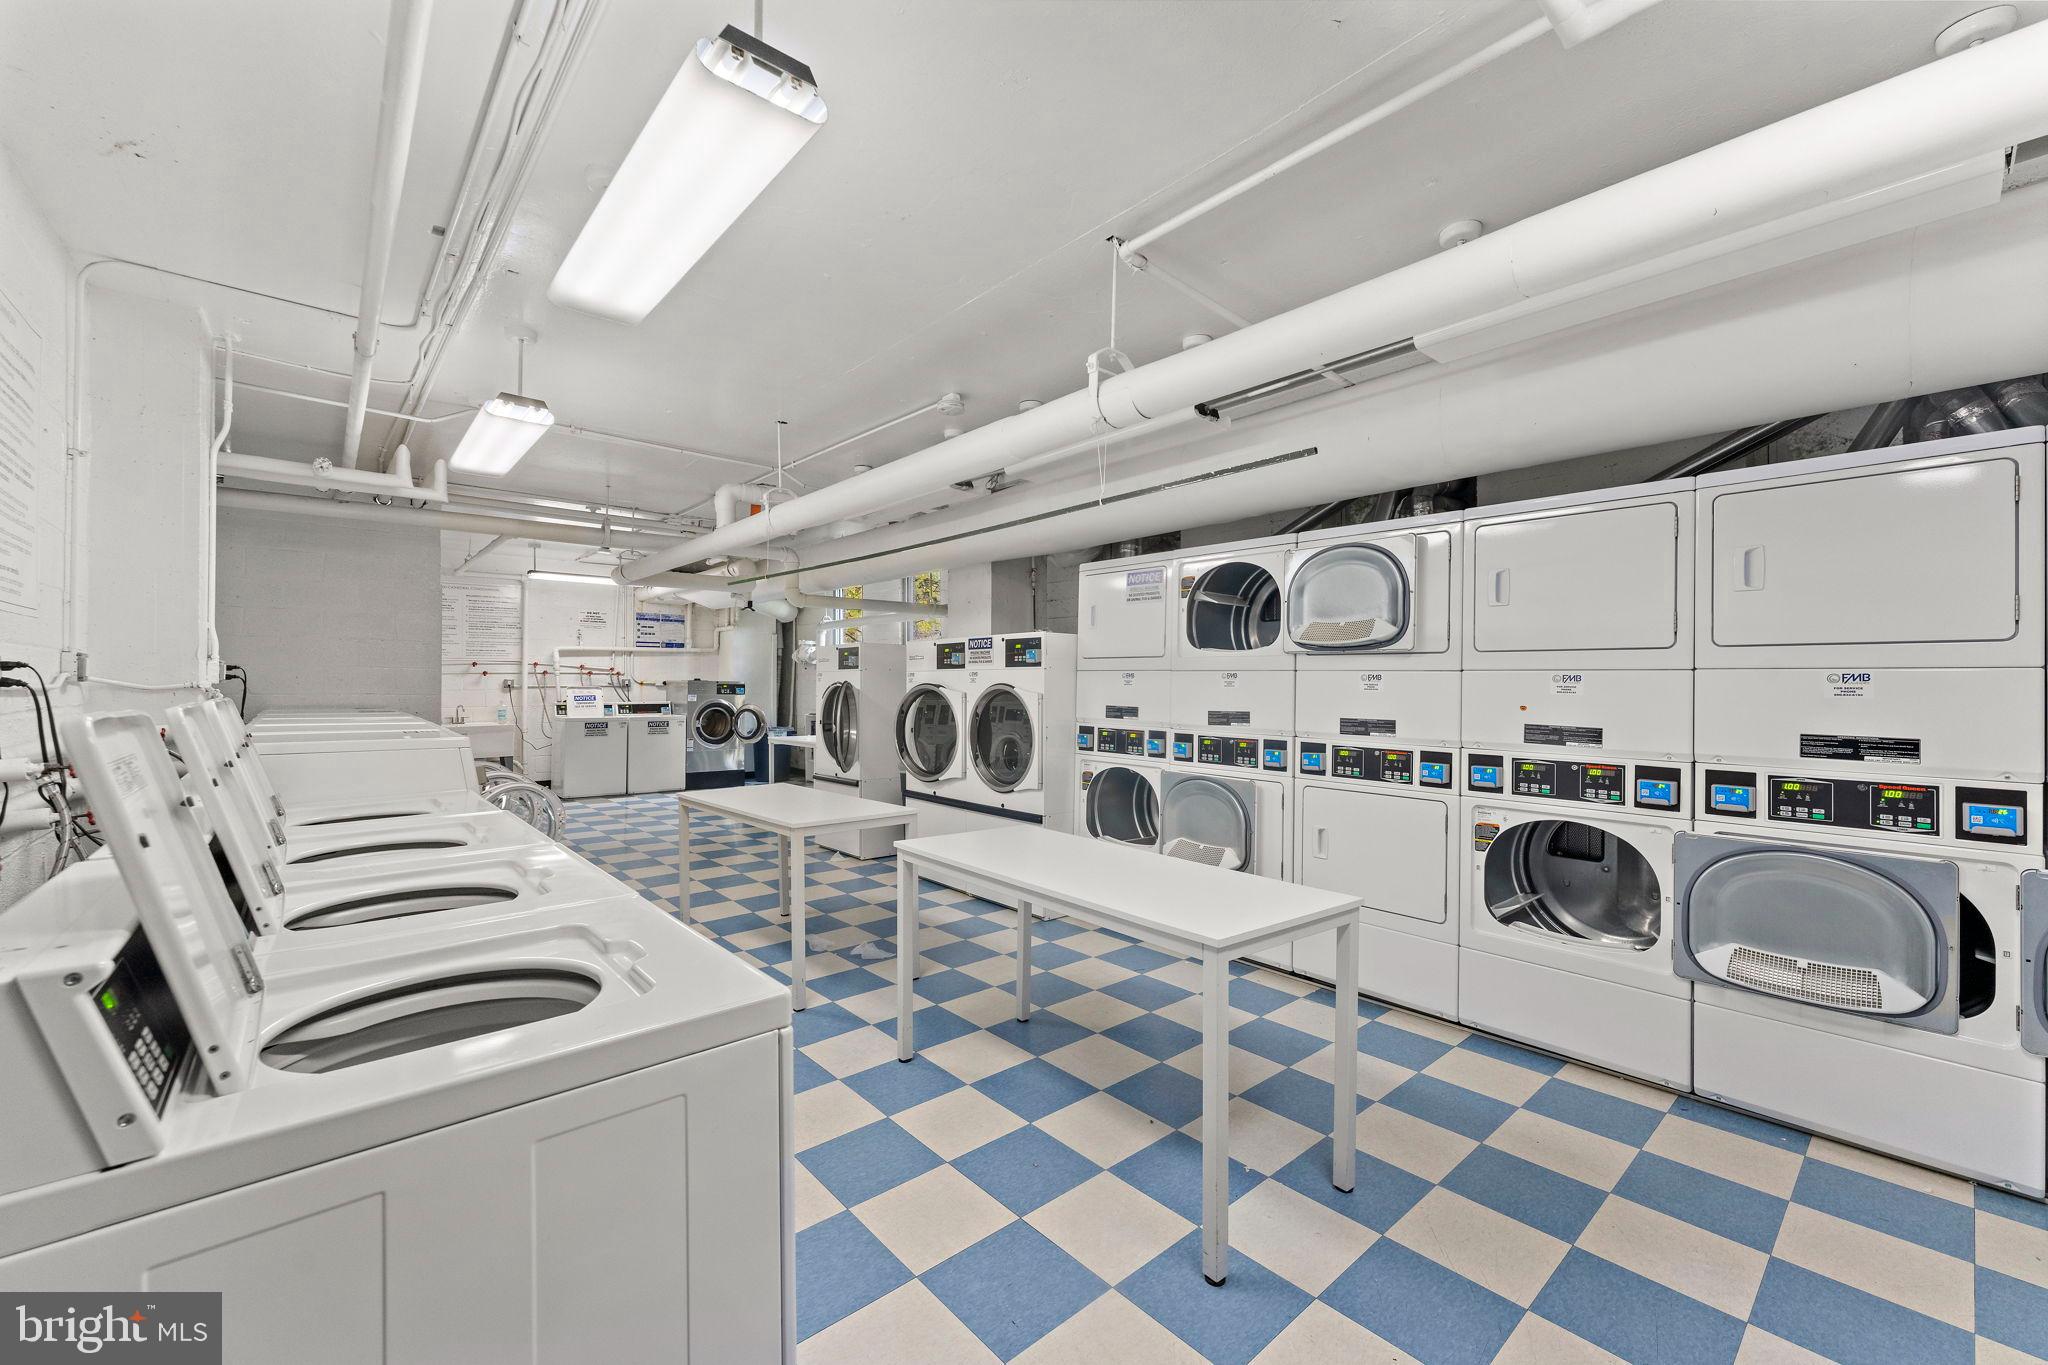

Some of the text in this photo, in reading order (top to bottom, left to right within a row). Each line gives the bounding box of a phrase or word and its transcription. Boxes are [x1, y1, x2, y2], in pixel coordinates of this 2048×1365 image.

[1128, 572, 1161, 585] NOTICE
[969, 639, 992, 649] NOTICE
[1562, 674, 1582, 684] FMB
[1841, 673, 1871, 684] FMB
